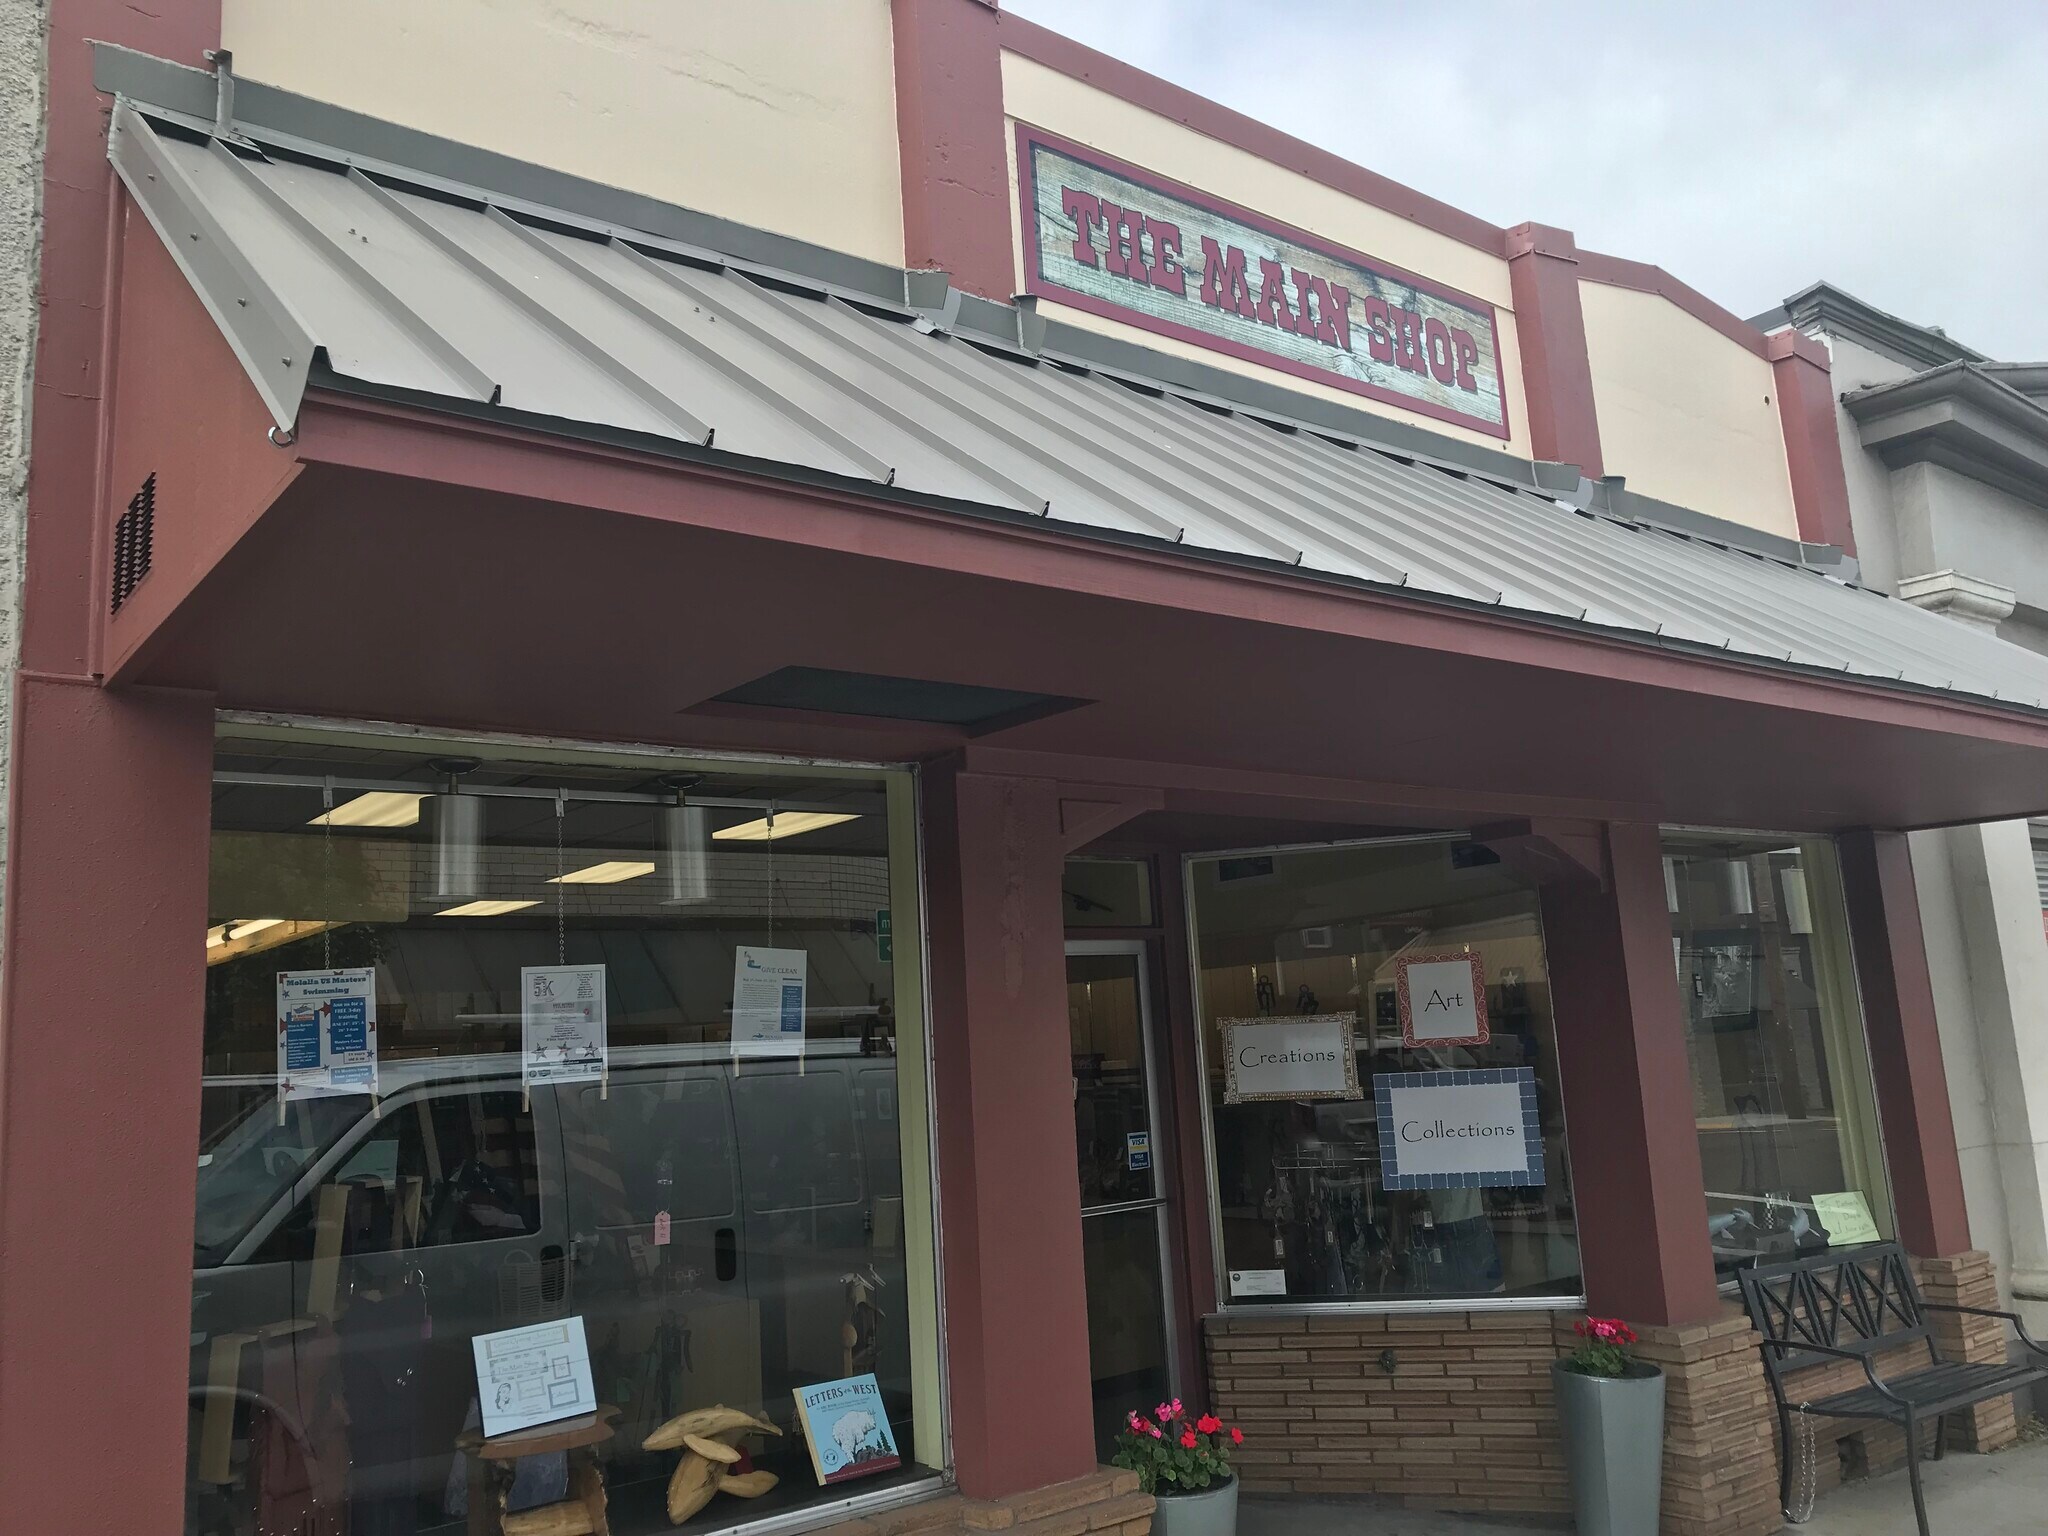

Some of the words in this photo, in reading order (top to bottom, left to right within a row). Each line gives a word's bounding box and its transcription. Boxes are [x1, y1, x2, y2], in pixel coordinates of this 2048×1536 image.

[1062, 186, 1187, 295] THE
[1200, 235, 1352, 353] MAIN
[1365, 296, 1479, 394] SHOP
[286, 978, 319, 987] Molalla
[303, 987, 349, 995] Swimming
[1424, 989, 1464, 1013] Art
[1239, 1047, 1336, 1068] Creations
[1401, 1120, 1515, 1143] Collections
[805, 1388, 844, 1408] LETTERS
[852, 1384, 877, 1394] WEST
